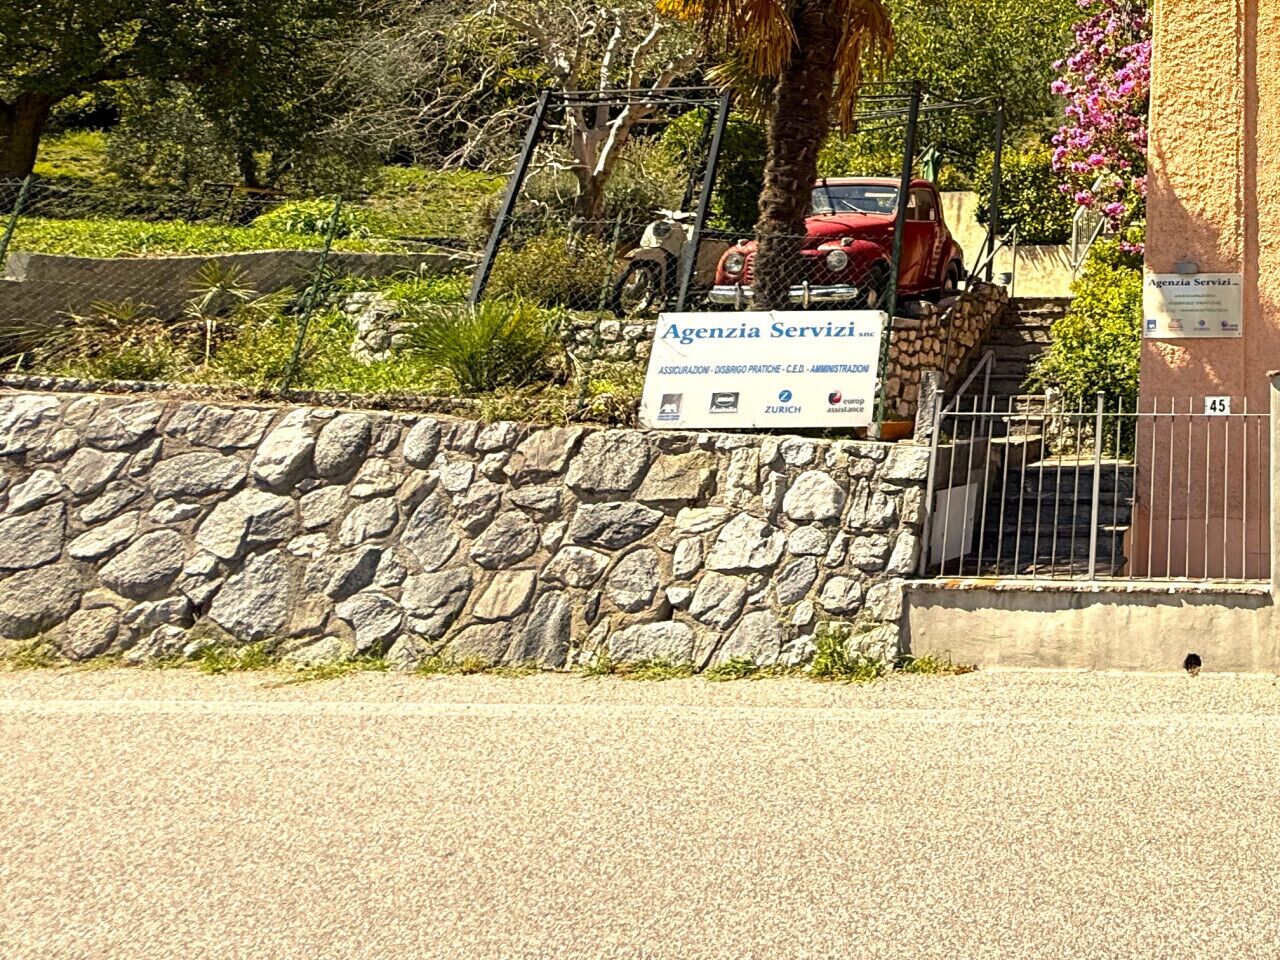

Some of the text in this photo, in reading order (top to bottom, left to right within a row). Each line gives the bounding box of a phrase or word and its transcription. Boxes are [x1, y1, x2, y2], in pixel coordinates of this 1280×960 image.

[1149, 278, 1190, 288] Agenzia
[1194, 278, 1231, 286] Servizi
[661, 323, 761, 345] Agenzia
[770, 322, 855, 338] Servizi
[658, 366, 710, 375] ASSICURAZIONI
[714, 365, 747, 374] DISBRIGO
[747, 365, 782, 374] PRATICHE
[810, 365, 870, 373] AMMINISTRAZIONI
[764, 406, 802, 414] ZURICH
[1210, 399, 1226, 413] 45
